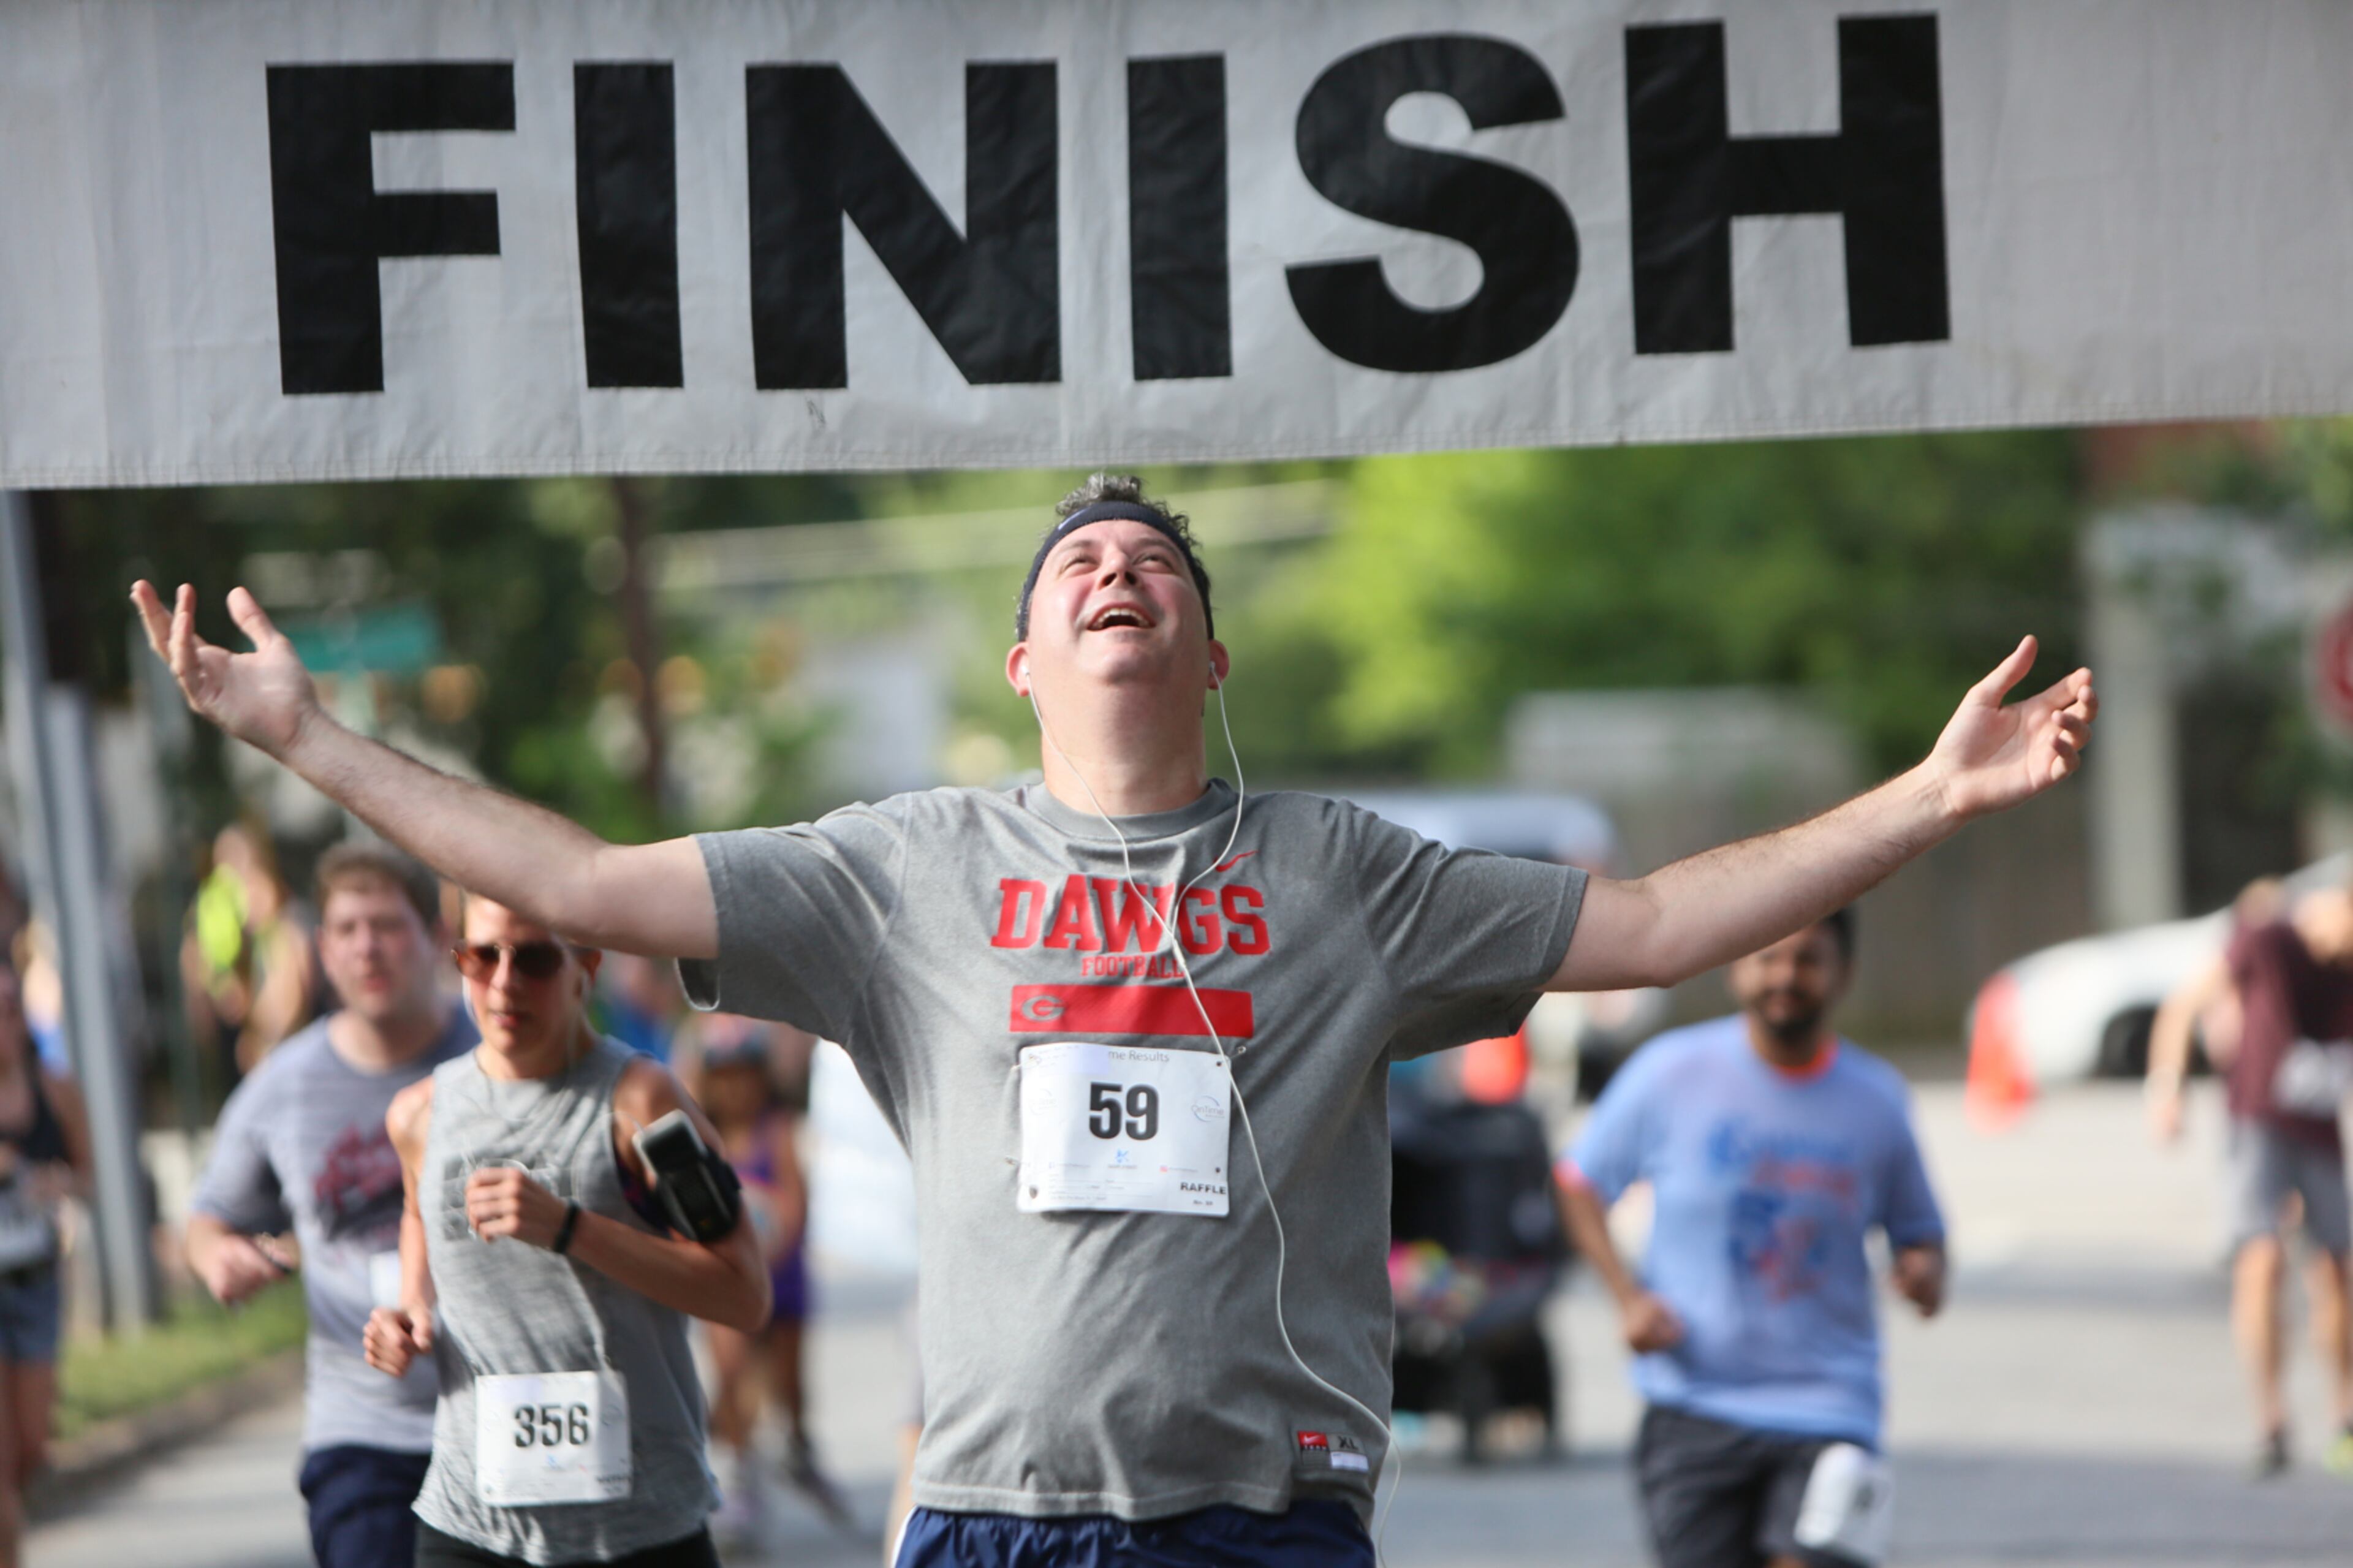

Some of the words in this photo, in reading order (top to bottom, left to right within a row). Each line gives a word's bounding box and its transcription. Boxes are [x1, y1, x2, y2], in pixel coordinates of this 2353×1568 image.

[266, 12, 1950, 395] FINISH
[990, 874, 1271, 955] DAWGS
[1080, 954, 1186, 979] FOOTBALL
[1021, 994, 1065, 1021] G
[1128, 1050, 1170, 1062] Results
[1089, 1081, 1159, 1141] 59
[1180, 1181, 1227, 1195] RAFFLE
[513, 1403, 589, 1447] 356
[1338, 1435, 1358, 1450] XL
